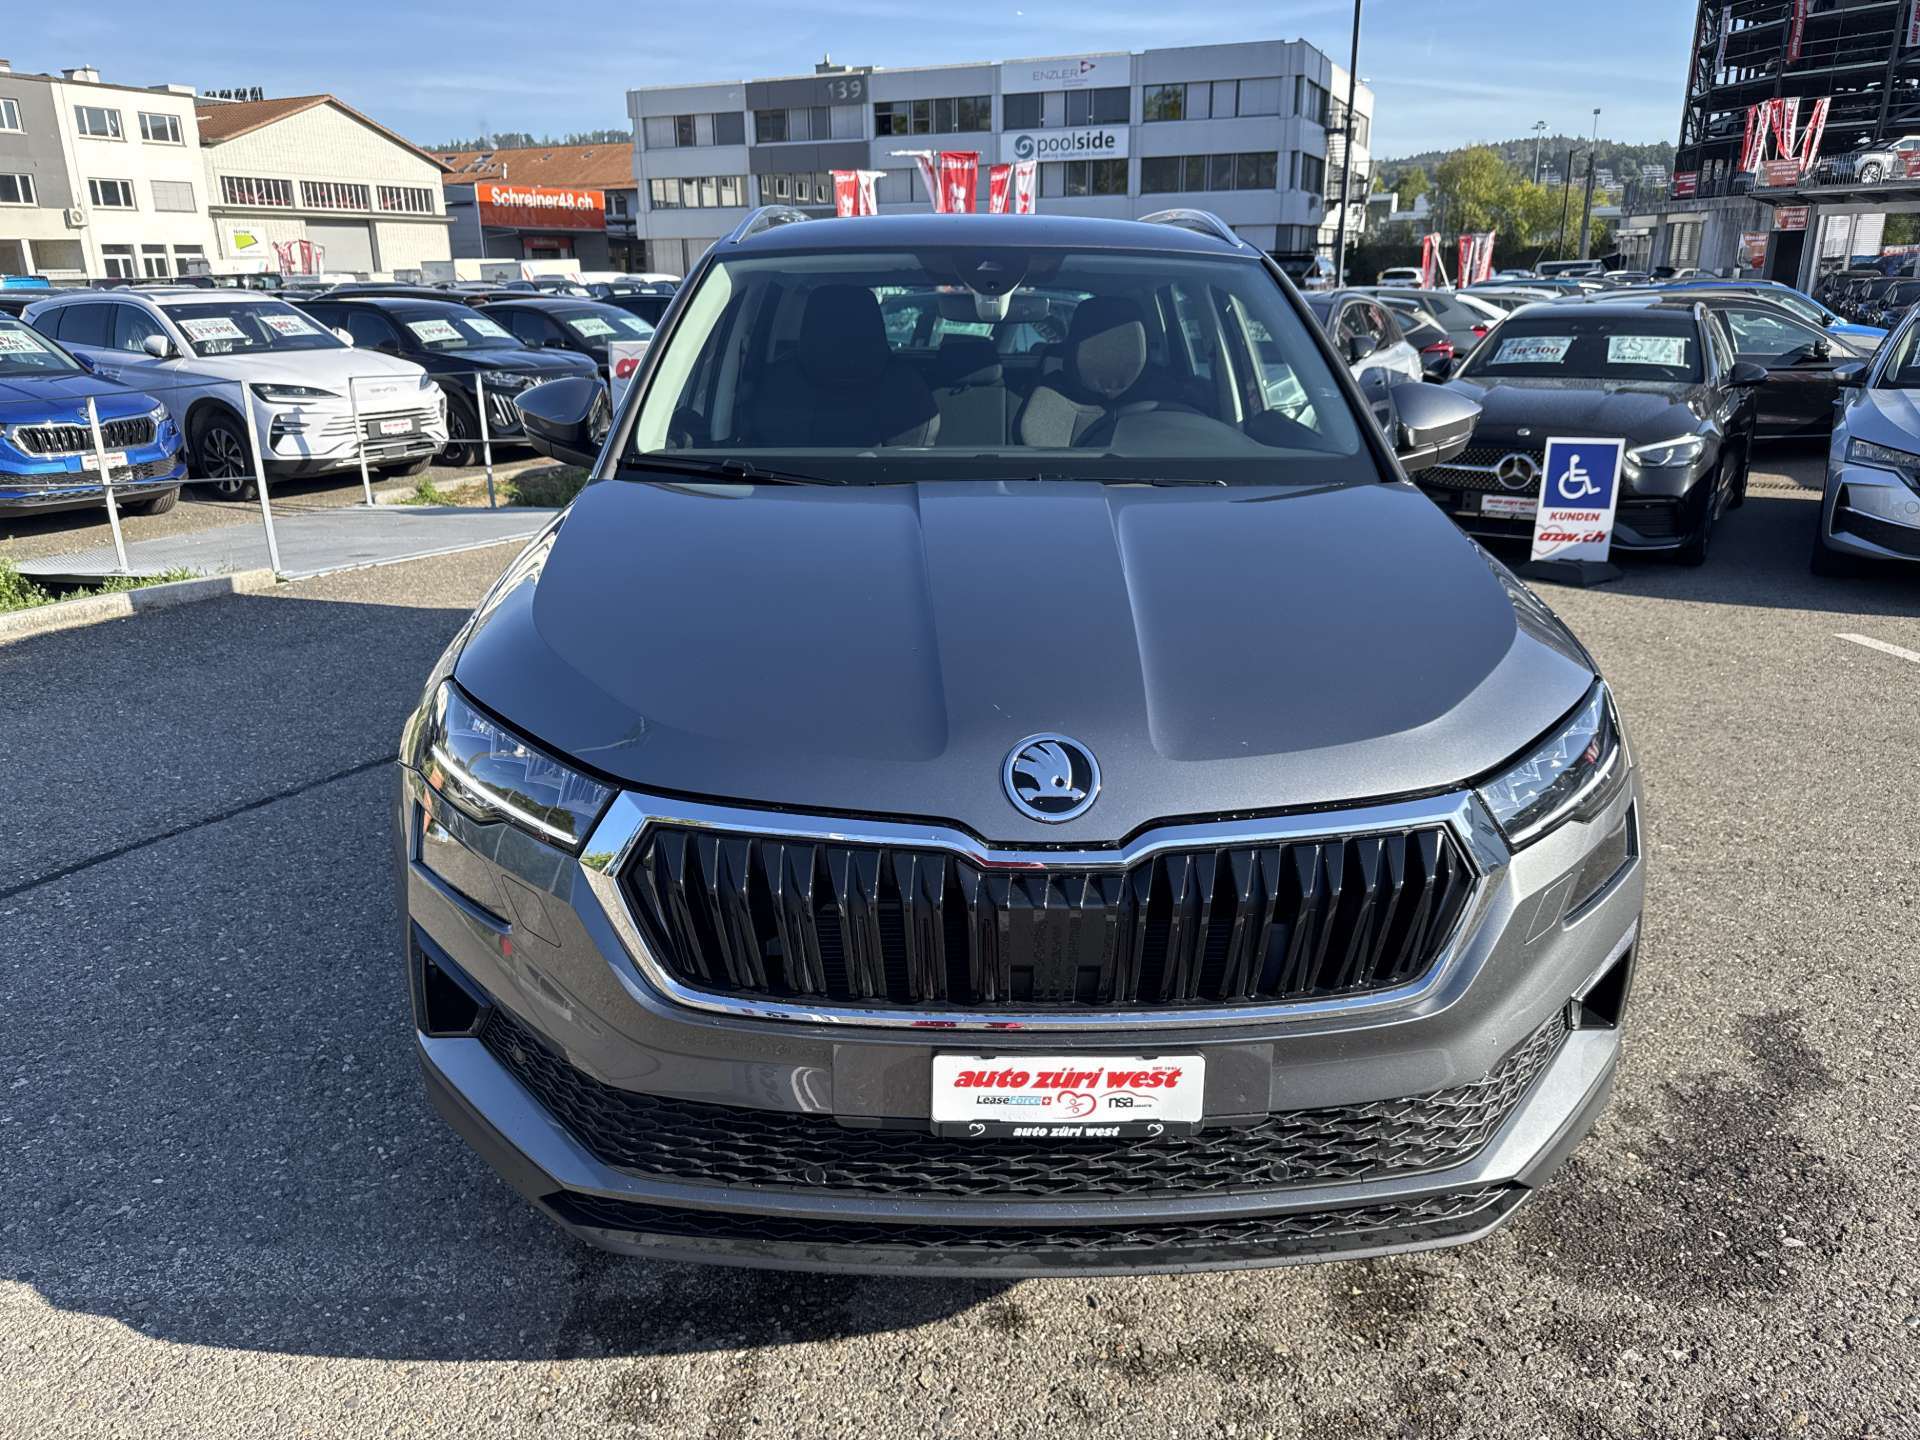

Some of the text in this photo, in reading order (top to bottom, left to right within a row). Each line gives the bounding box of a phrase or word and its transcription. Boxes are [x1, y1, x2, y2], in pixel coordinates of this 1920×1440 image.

[1032, 69, 1079, 81] ENZLER
[828, 80, 862, 99] 139
[1037, 131, 1115, 158] poolside
[491, 187, 594, 211] Schreiner48.ch
[1549, 512, 1601, 522] KUNDEN
[1538, 531, 1607, 544] azw.ch
[954, 1067, 1182, 1089] auto züri west
[976, 1096, 1041, 1106] LeaseForce
[1109, 1097, 1133, 1108] nsa
[1013, 1126, 1120, 1137] auto züri west
